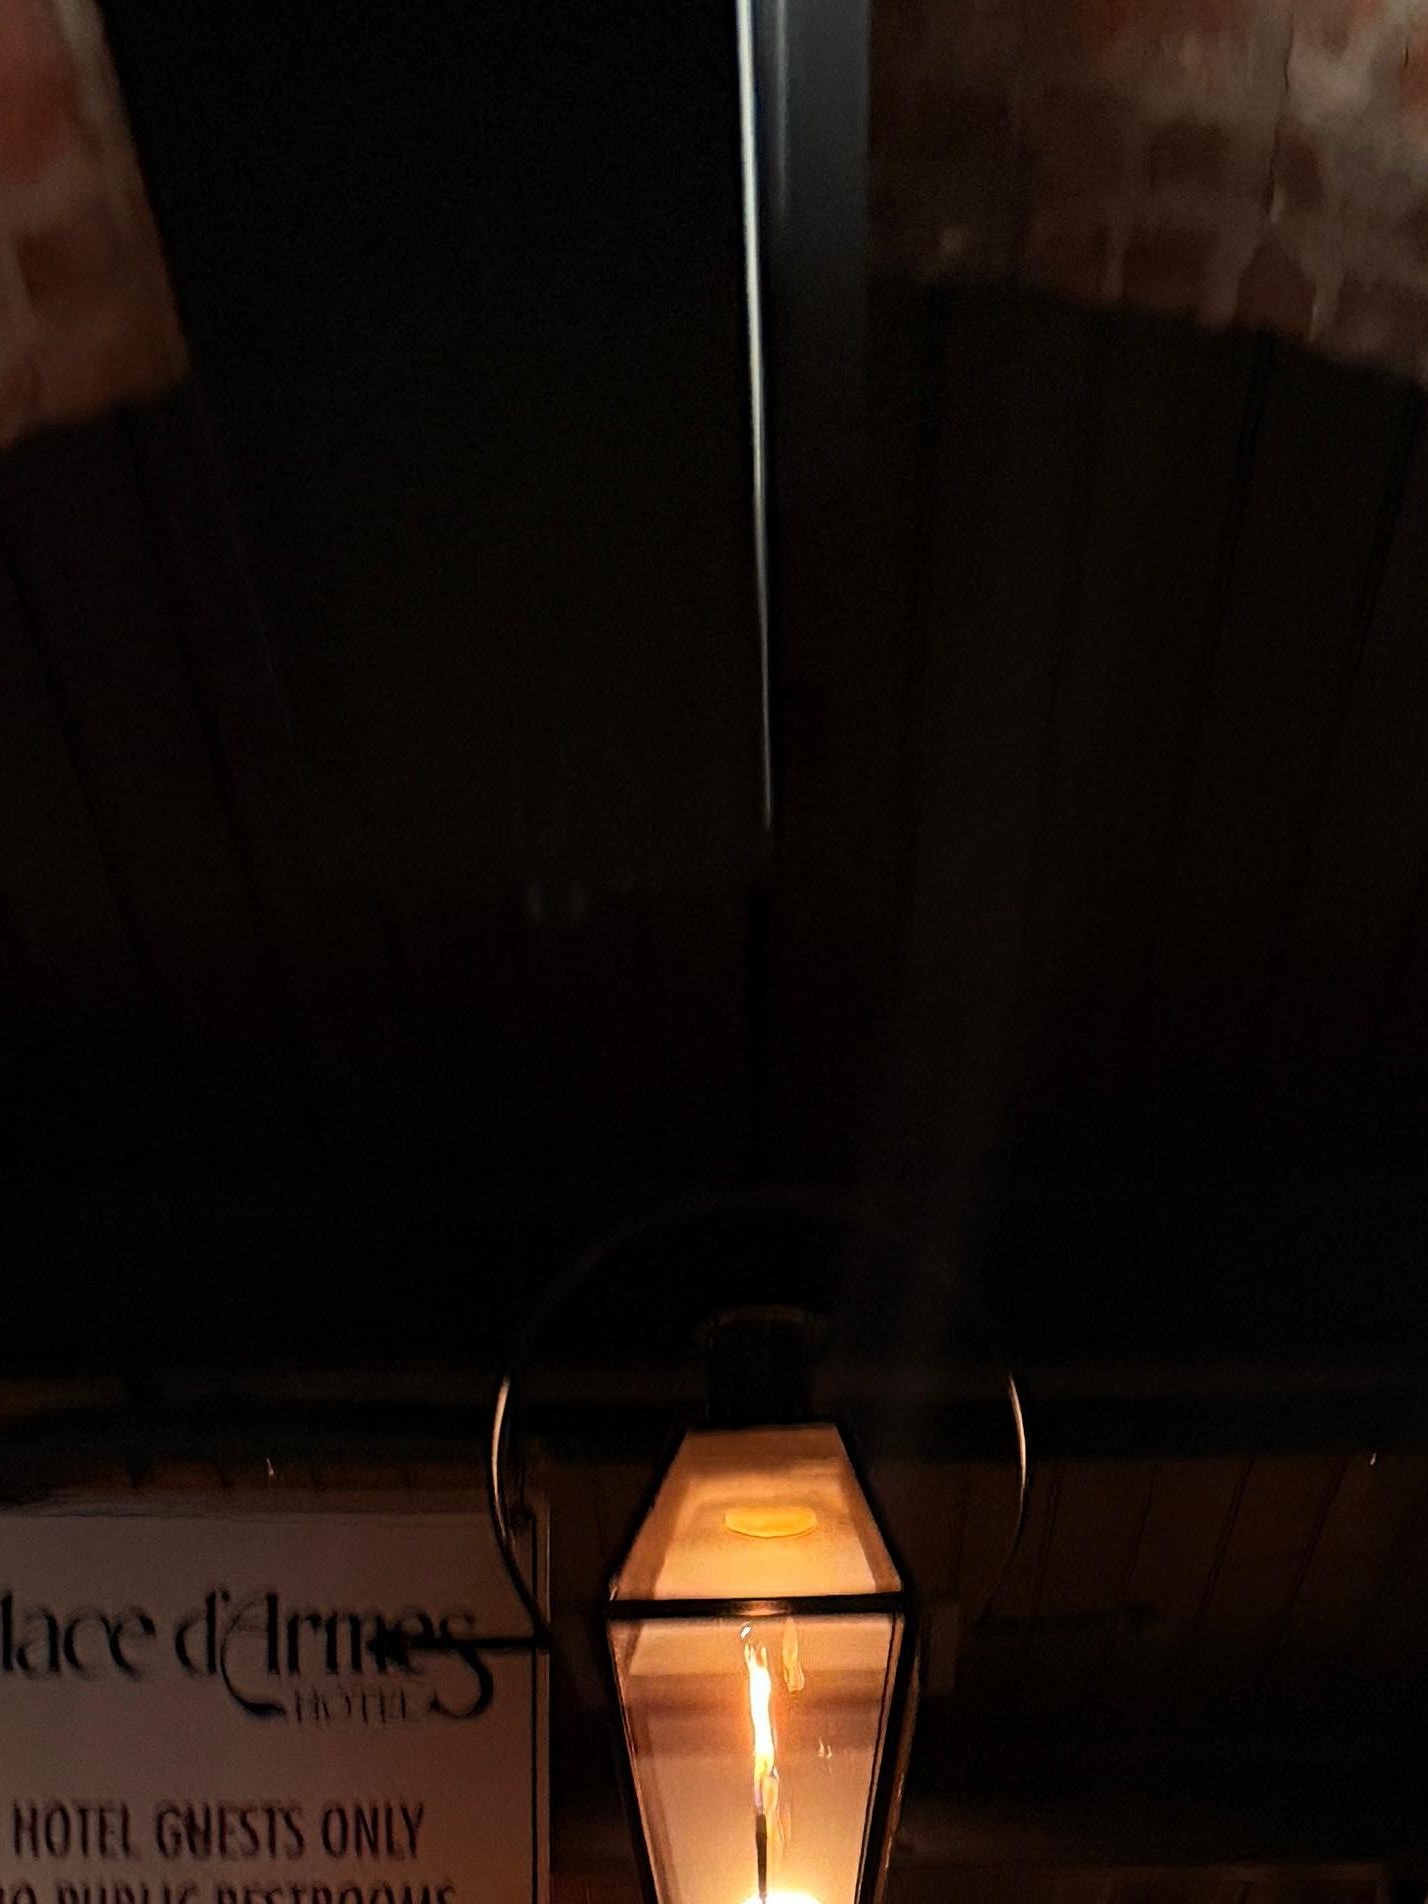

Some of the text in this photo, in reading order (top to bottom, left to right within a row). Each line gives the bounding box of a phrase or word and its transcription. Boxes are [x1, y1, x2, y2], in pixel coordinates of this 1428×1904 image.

[293, 1687, 418, 1725] HOTEL
[13, 1803, 424, 1859] HOTEL GUESTS ONLY
